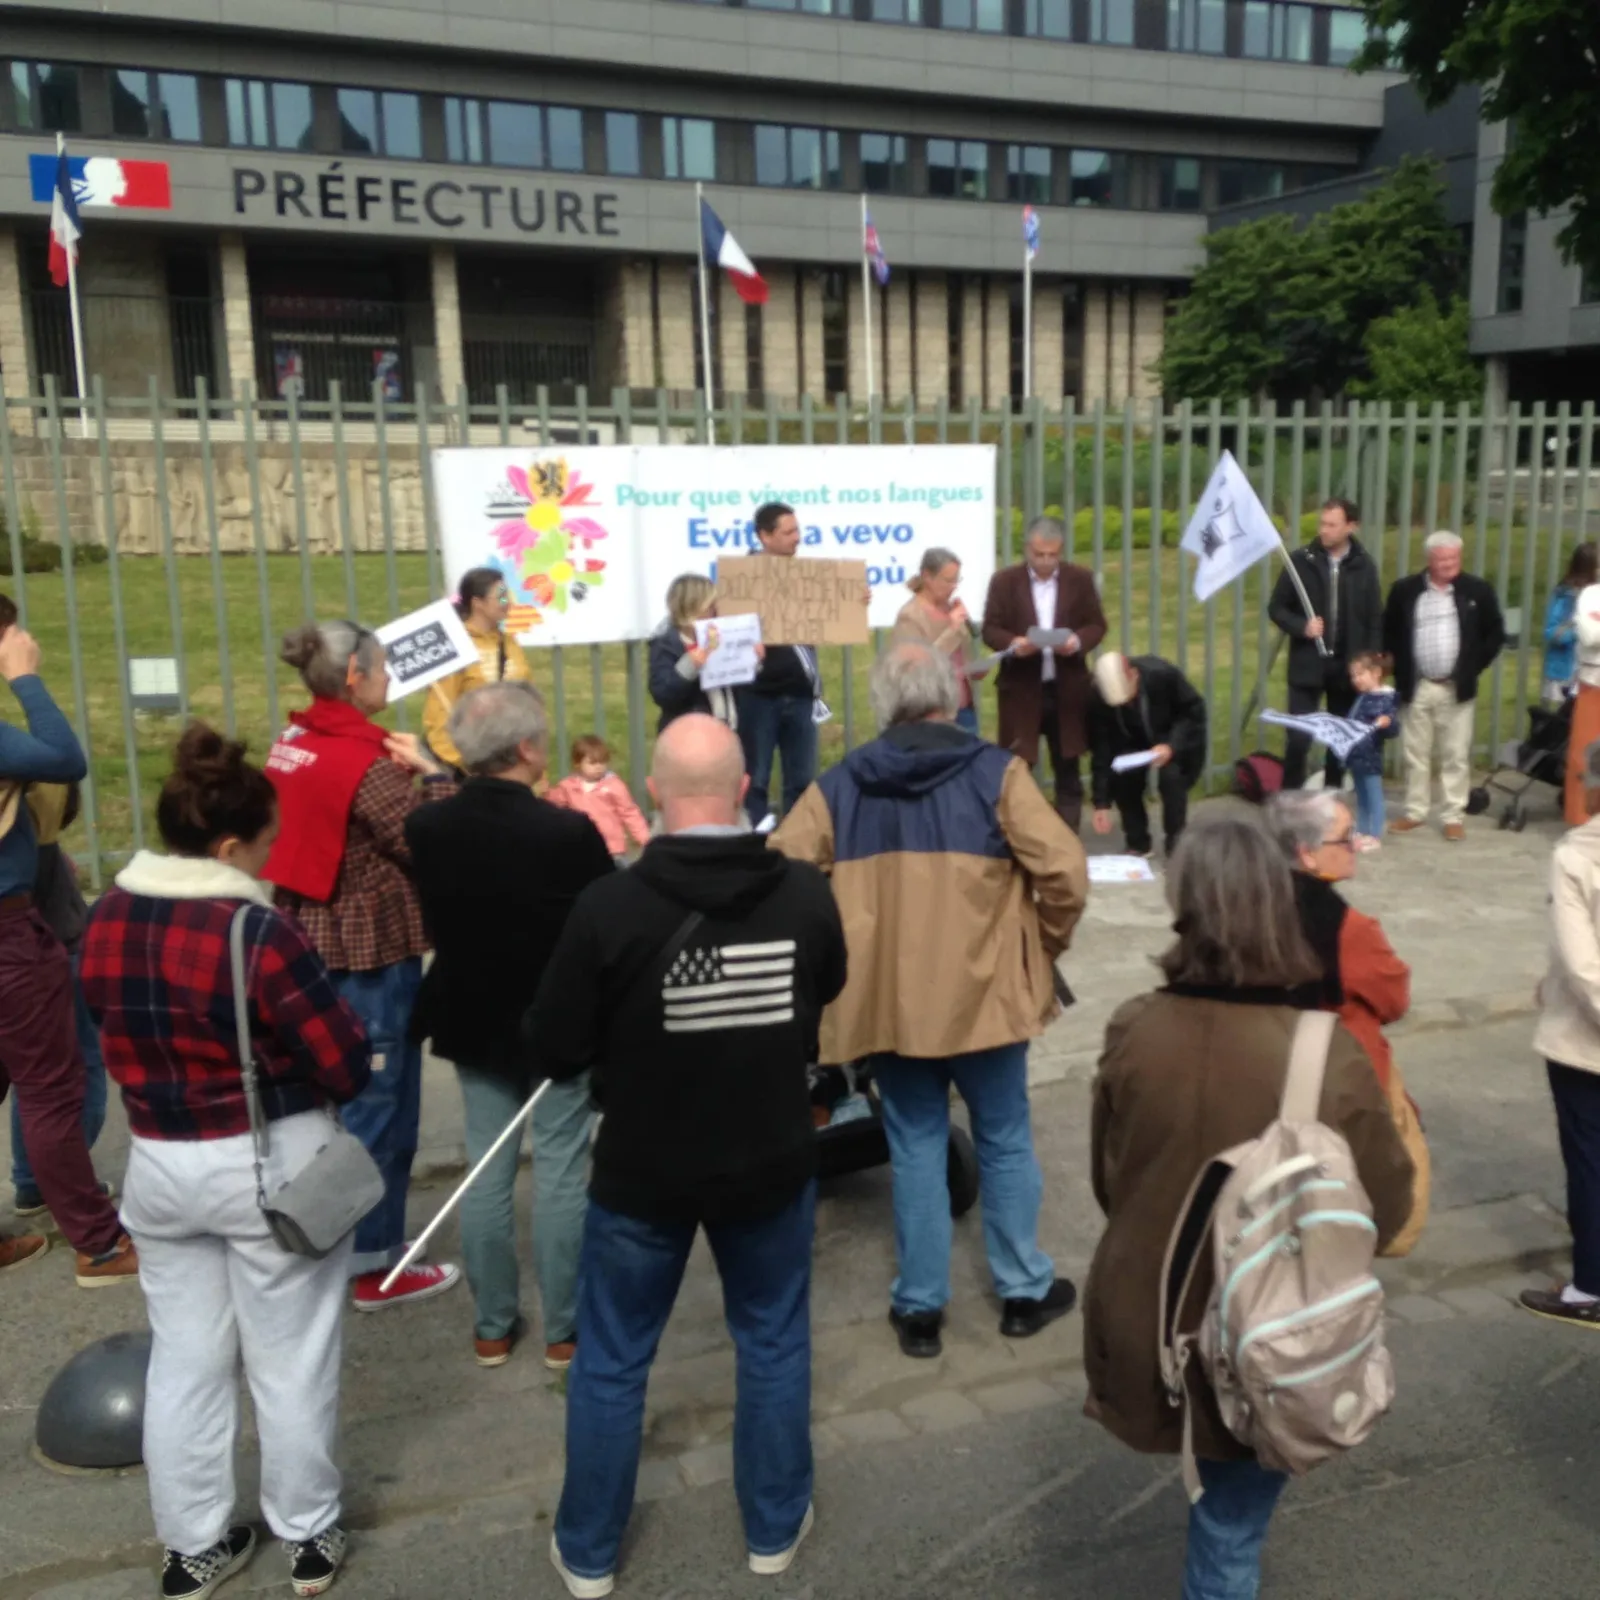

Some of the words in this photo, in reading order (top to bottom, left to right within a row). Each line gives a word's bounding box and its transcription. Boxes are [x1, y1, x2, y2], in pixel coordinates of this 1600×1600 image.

[232, 161, 620, 236] PRÉFECTURE
[616, 484, 682, 506] Pour
[689, 489, 741, 512] que
[749, 482, 831, 505] vivent
[838, 487, 882, 504] nos
[889, 481, 983, 509] langues
[832, 523, 914, 545] vevo
